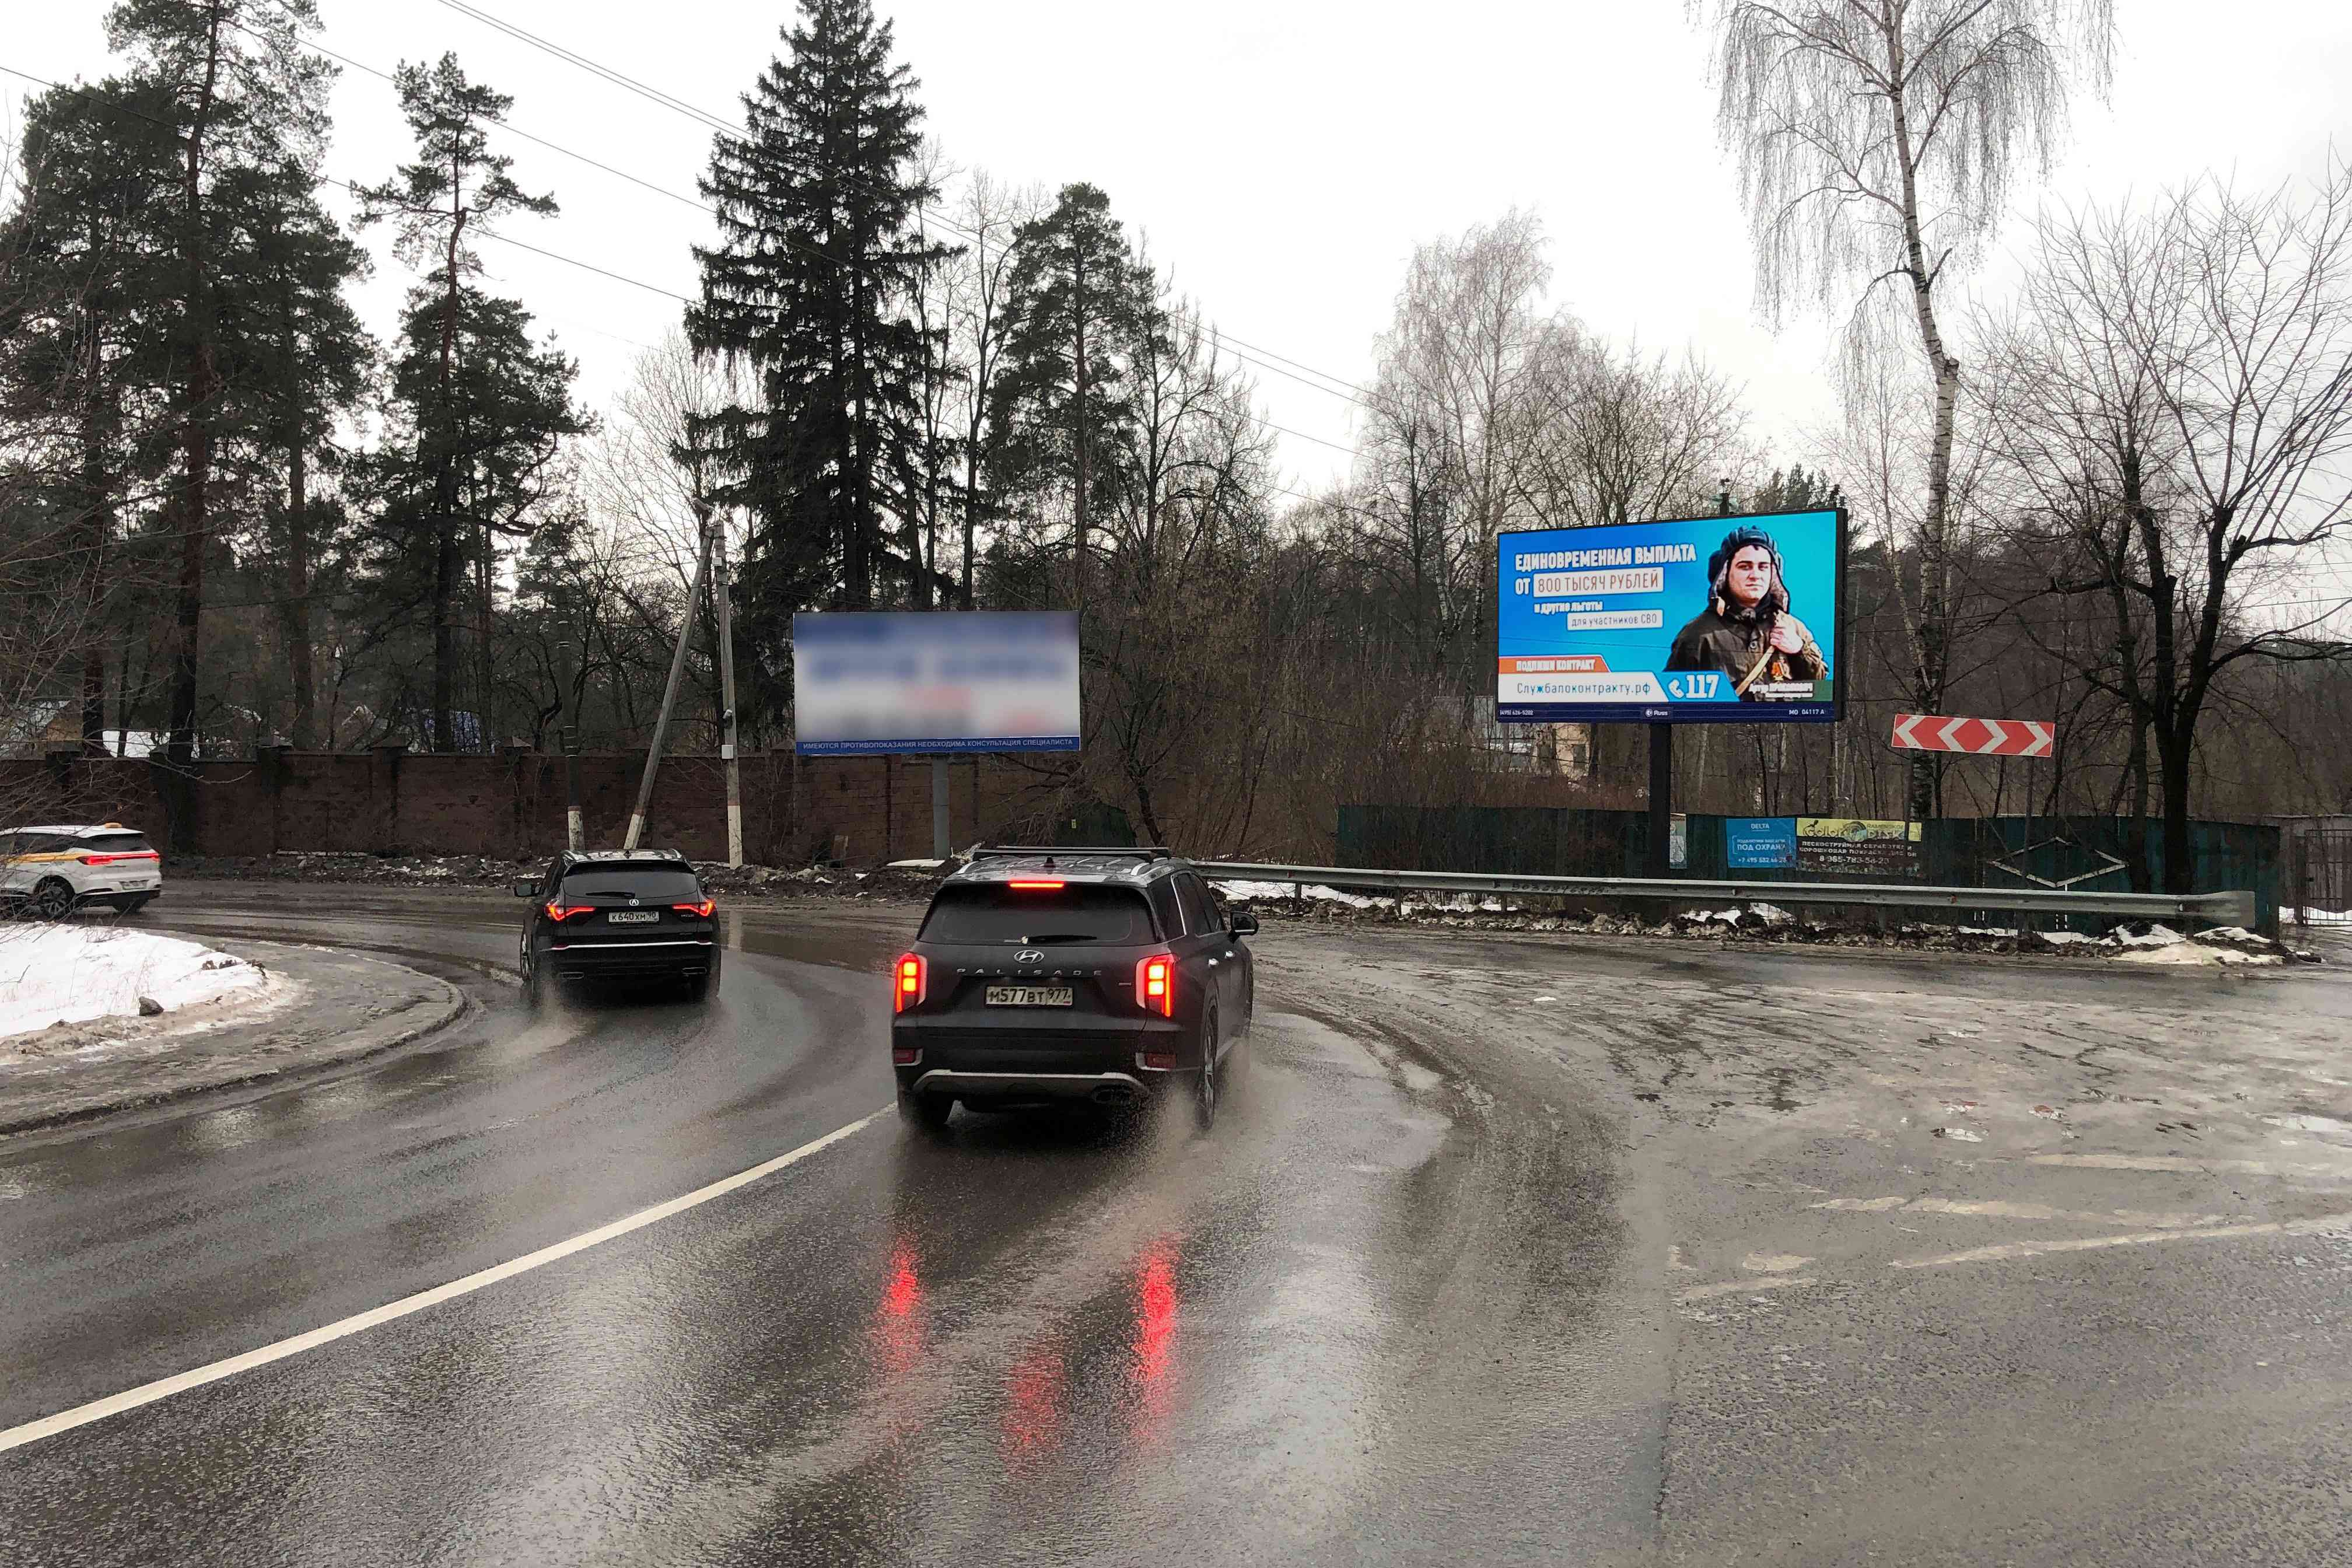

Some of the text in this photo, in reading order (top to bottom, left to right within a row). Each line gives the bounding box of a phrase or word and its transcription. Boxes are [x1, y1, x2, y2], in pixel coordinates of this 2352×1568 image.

[1516, 544, 1696, 572] ЕДИНОВРЕМЕННАЯ ВЫПЛАТА
[1515, 569, 1658, 594] ОТ 800 ТЫСЯЧ РУБЛЕЙ
[1572, 614, 1657, 627] для участников СВО
[1517, 681, 1650, 696] Службапоконтракту.рф
[1686, 674, 1720, 699] 117
[803, 738, 1073, 750] ИМЕЮТСЯ ПРОТИВОПОКАЗАНИЯ НЕОБХОДИМА КОНСУЛЬТАЦИЯ СПЕЦИАЛИСТА
[956, 968, 1101, 976] PALISADE
